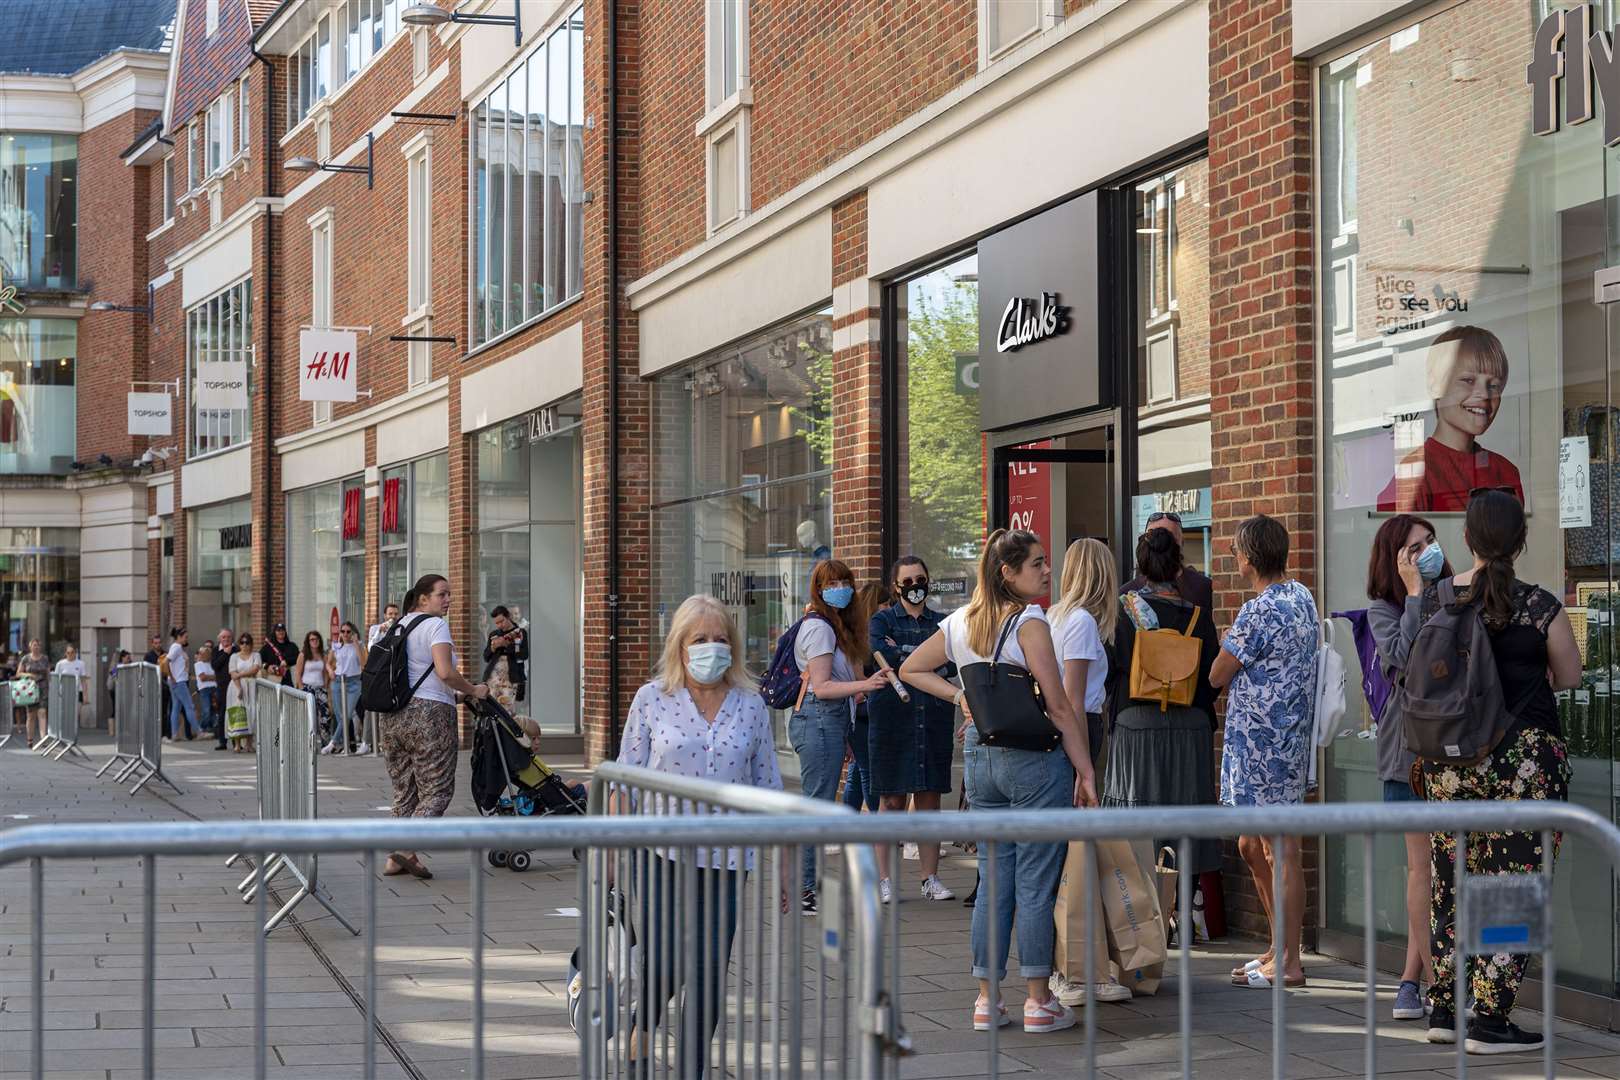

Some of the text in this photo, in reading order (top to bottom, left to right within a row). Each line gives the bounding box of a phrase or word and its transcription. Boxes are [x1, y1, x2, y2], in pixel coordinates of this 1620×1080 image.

[1376, 274, 1415, 293] Nice
[1376, 294, 1469, 313] to see you
[997, 291, 1057, 353] Clarks
[306, 351, 350, 380] H&M
[204, 381, 243, 390] TOPSHOP
[133, 409, 168, 418] TOPSHOP
[530, 407, 553, 440] ZARA
[711, 570, 756, 607] WELCOME
